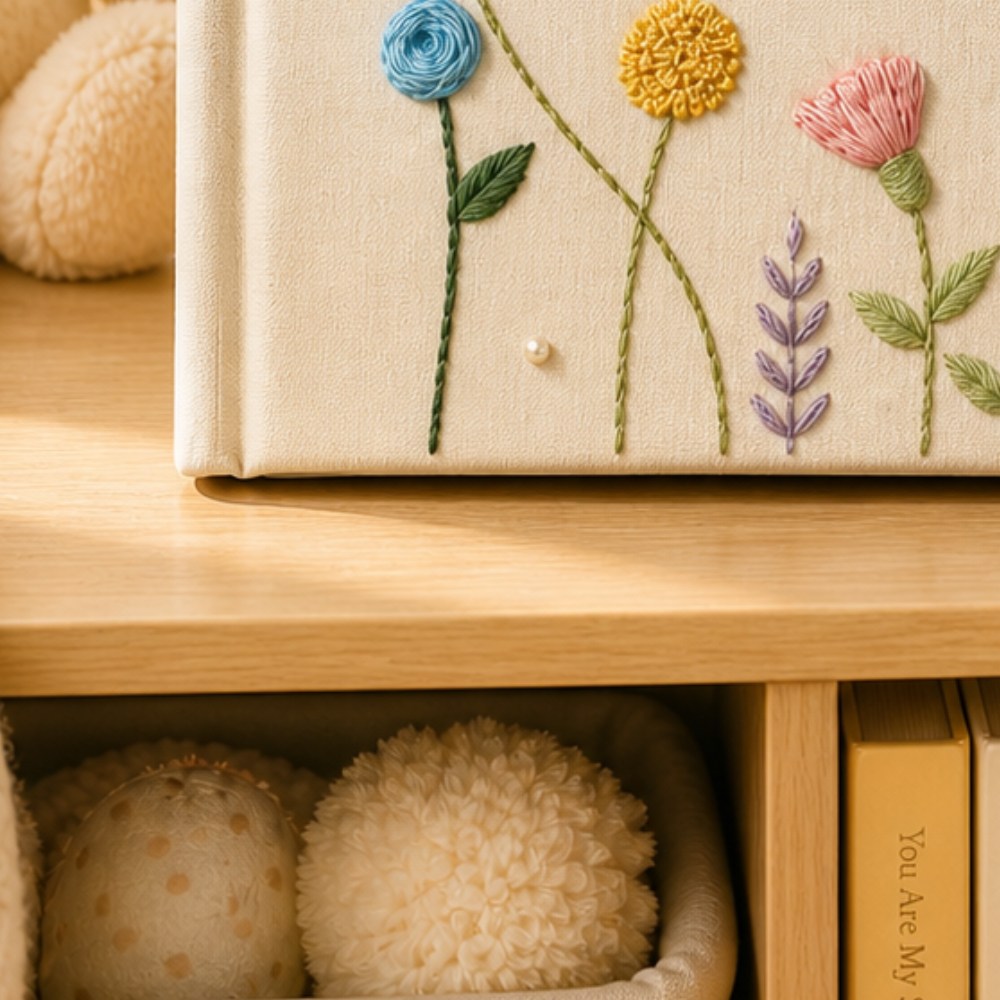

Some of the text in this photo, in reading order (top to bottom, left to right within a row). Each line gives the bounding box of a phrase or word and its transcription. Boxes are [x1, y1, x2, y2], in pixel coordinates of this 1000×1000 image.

[898, 827, 926, 880] You
[899, 888, 925, 935] Are
[892, 945, 926, 987] My
